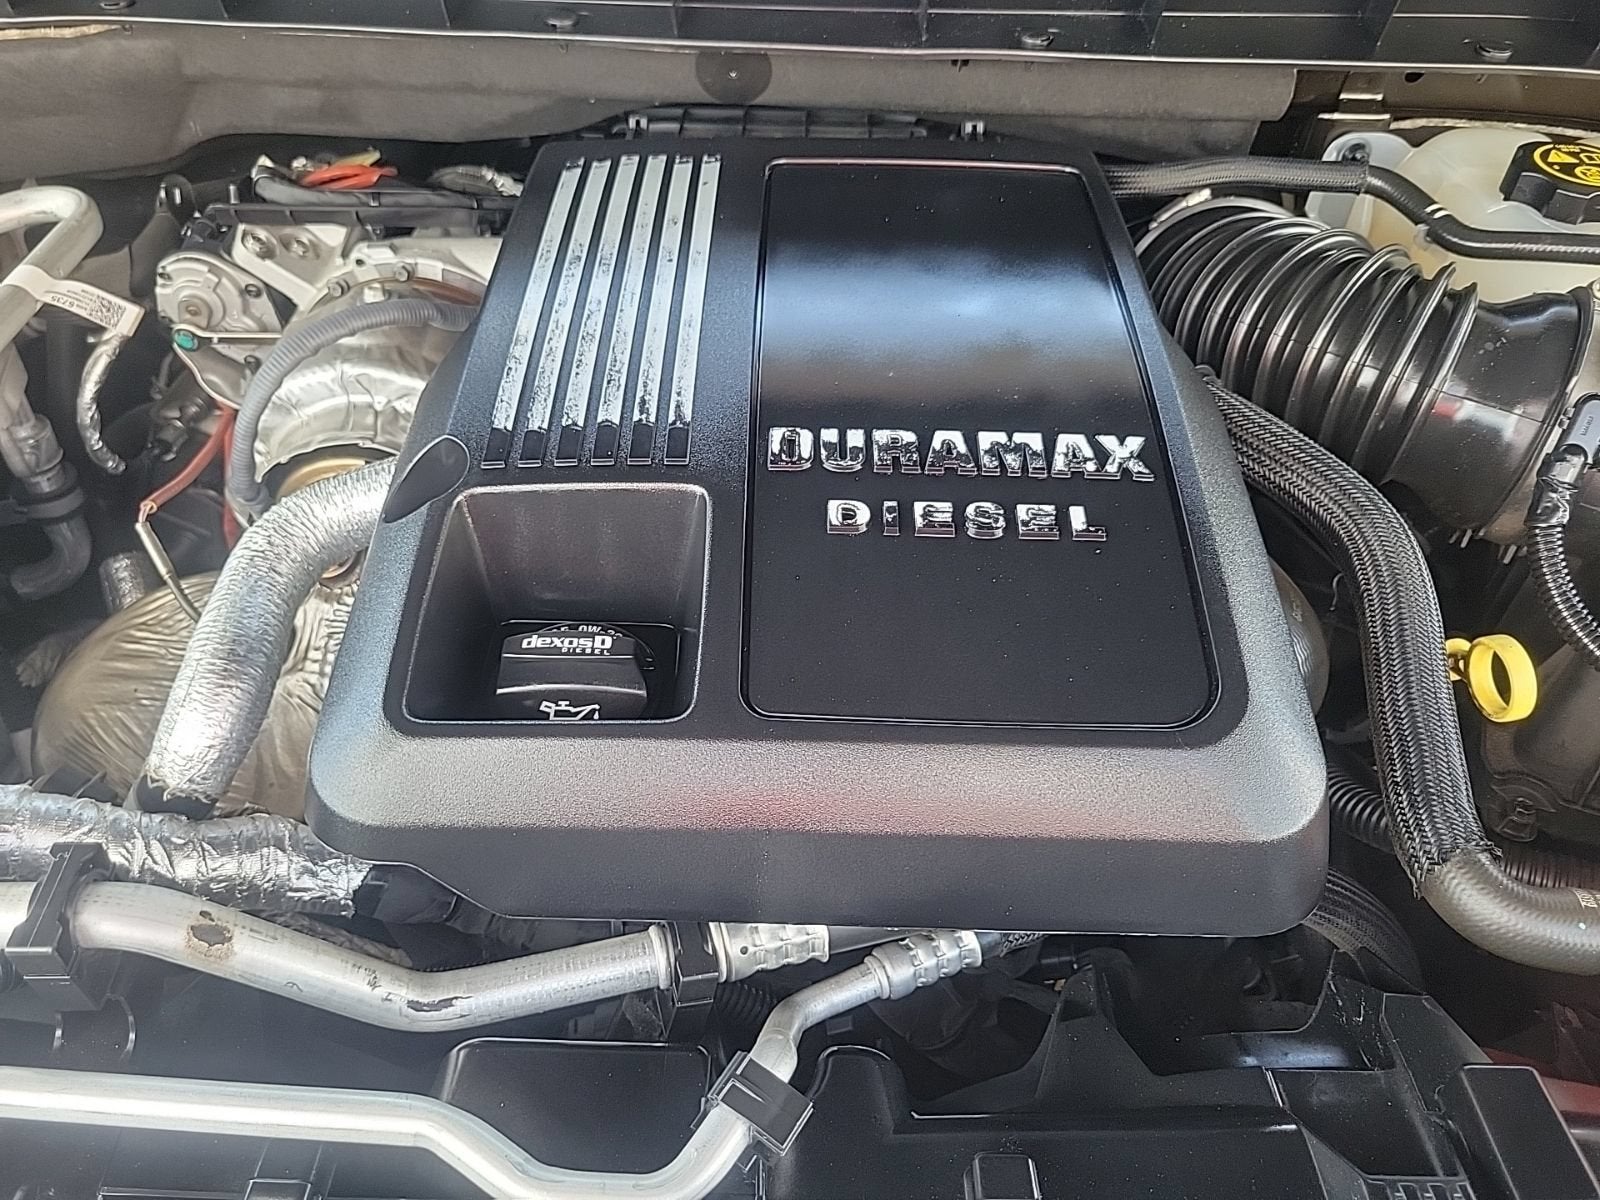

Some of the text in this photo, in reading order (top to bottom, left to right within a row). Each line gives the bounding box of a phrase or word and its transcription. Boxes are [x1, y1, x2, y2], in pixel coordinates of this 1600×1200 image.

[767, 426, 1156, 482] DURAMAX
[826, 499, 1107, 541] DIESEL
[521, 635, 613, 649] dexosD
